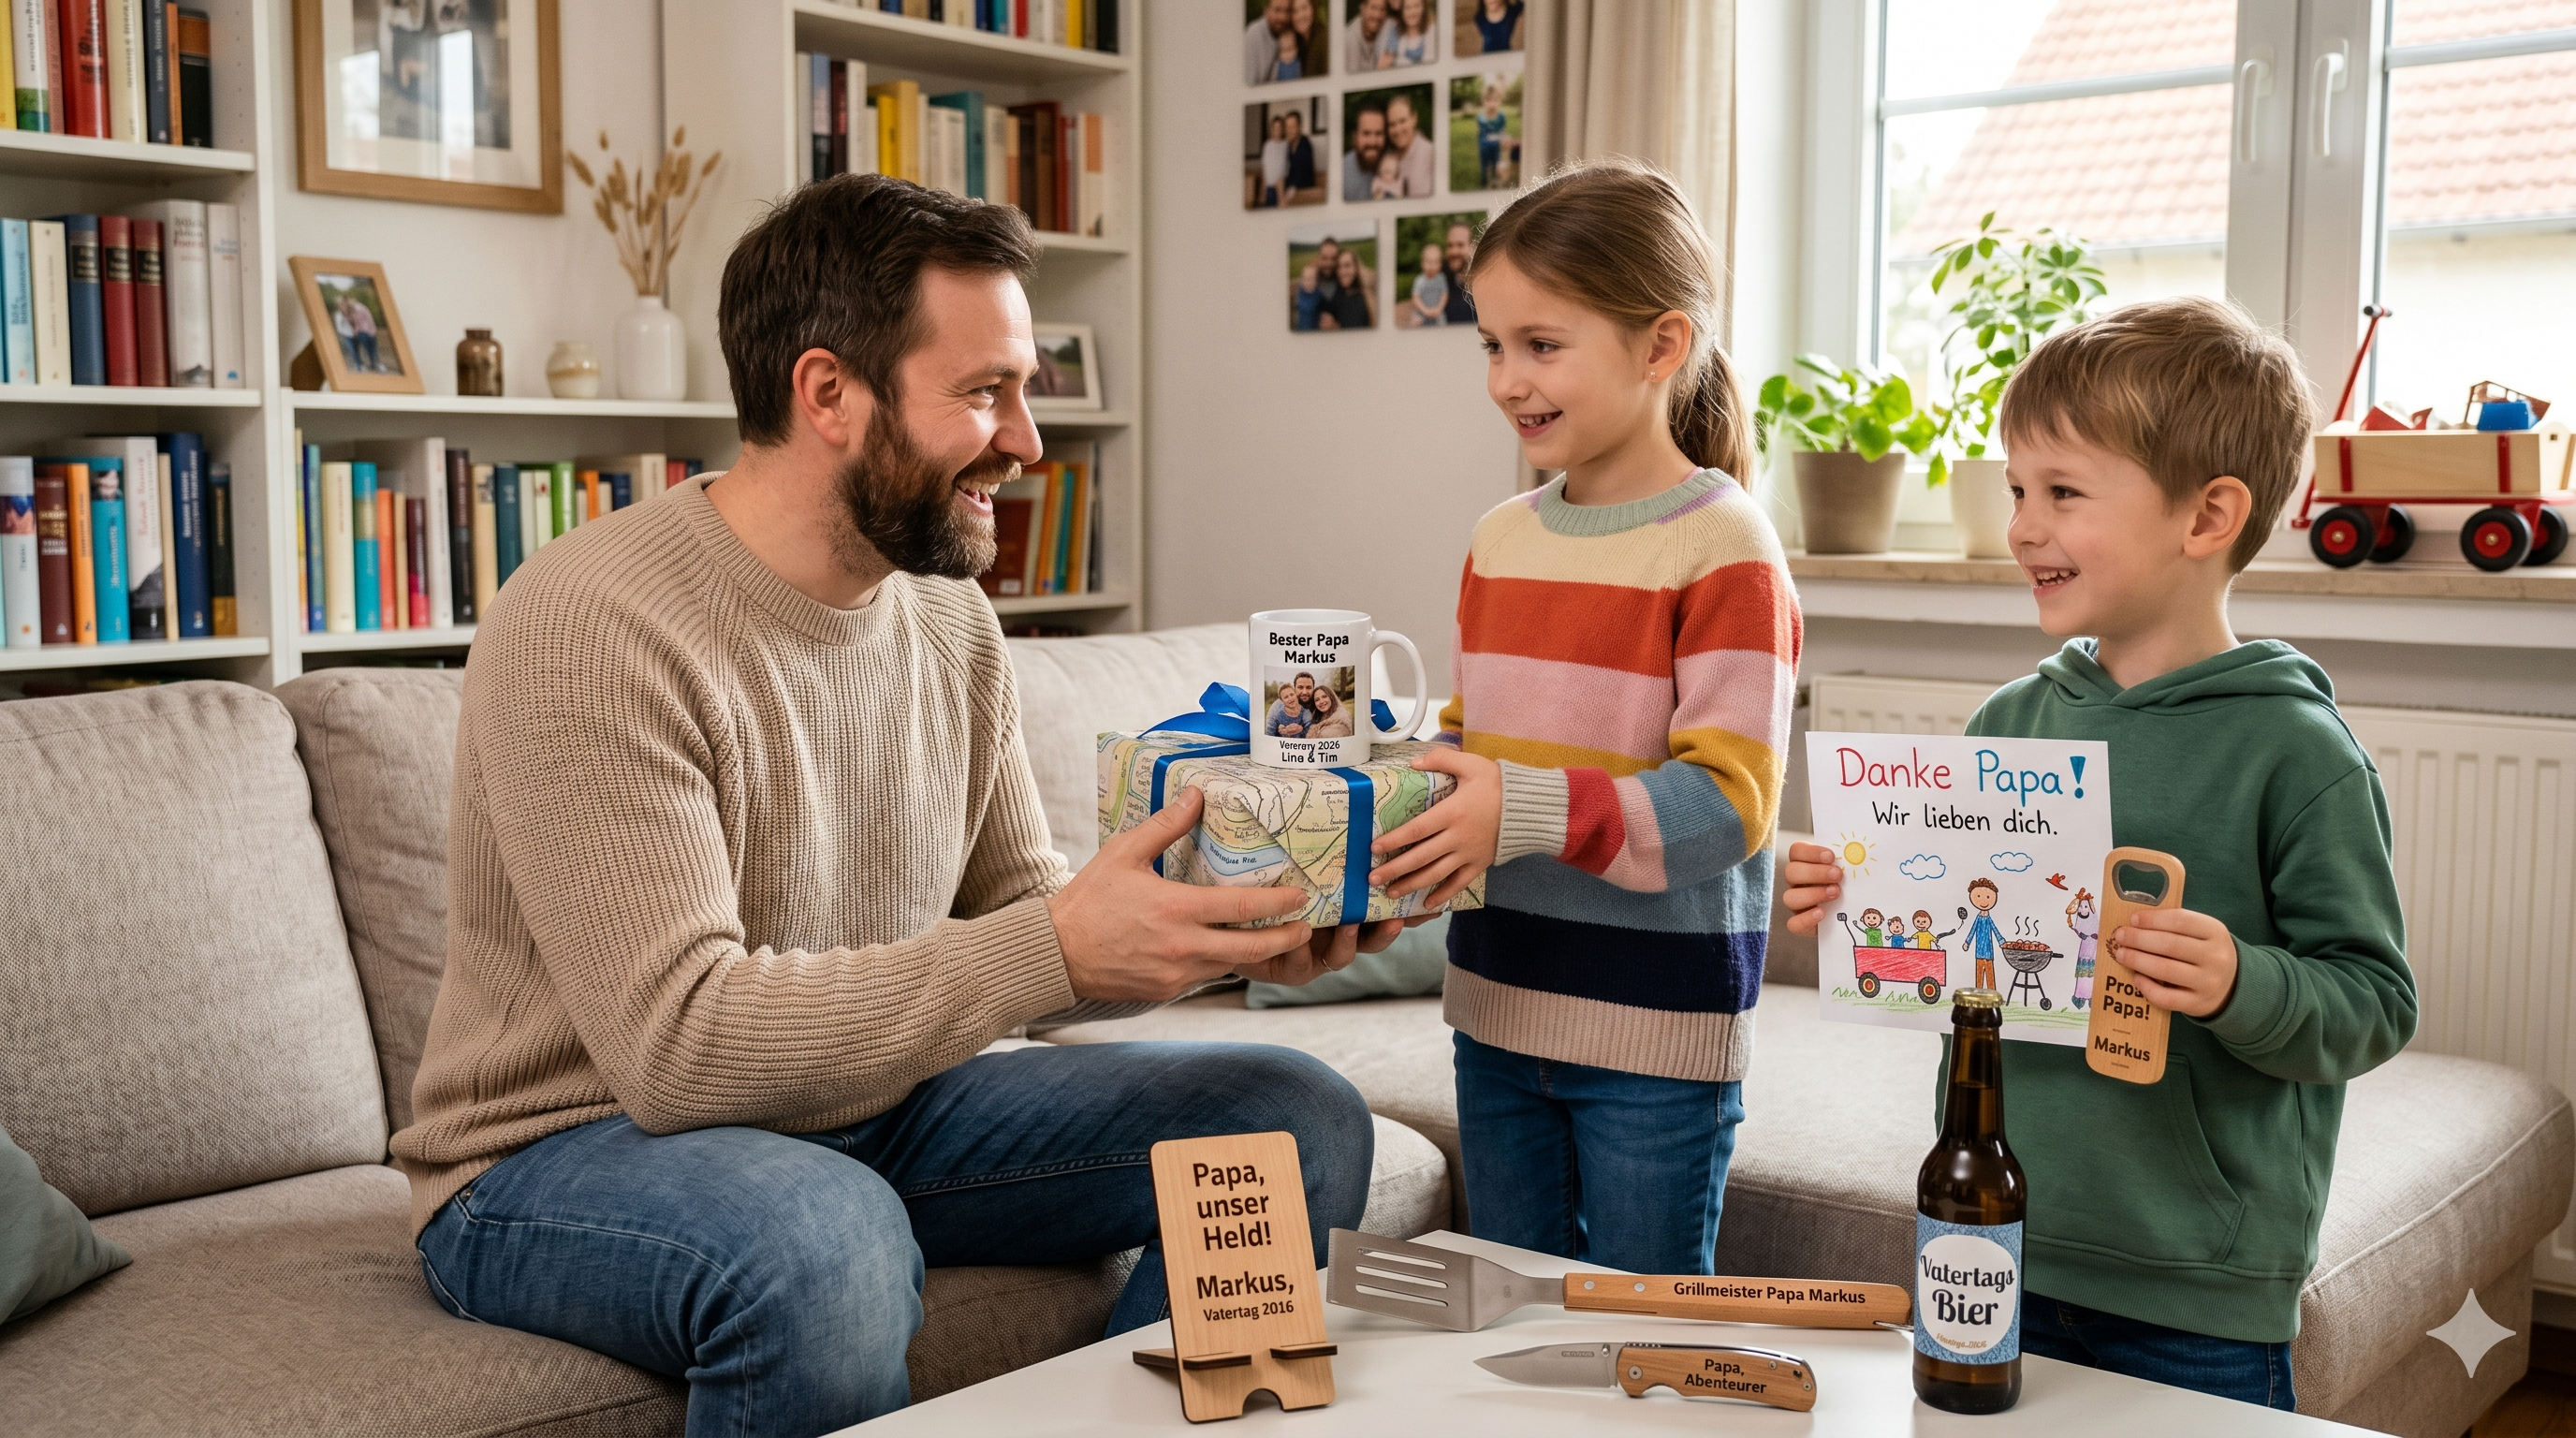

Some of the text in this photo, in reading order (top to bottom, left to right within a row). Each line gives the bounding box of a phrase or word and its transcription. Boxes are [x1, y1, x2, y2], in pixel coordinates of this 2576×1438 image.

[1269, 632, 1349, 649] Bester Papa
[1284, 650, 1337, 663] Markus
[1307, 751, 1315, 763] &
[1318, 753, 1338, 762] Tim
[1318, 741, 1340, 750] 2026
[1837, 747, 1952, 788] Danke
[1872, 801, 2058, 835] Wir lieben dich.
[2103, 995, 2150, 1020] Papa!
[2094, 1035, 2150, 1062] Markus
[1193, 1163, 1265, 1191] Papa,
[1197, 1196, 1269, 1219] unser
[1204, 1221, 1272, 1251] Held!
[1196, 1271, 1295, 1299] Markus,
[1920, 1255, 2014, 1293] Vatertags
[1674, 1282, 1866, 1303] Grillmeister Papa Markus
[1204, 1300, 1295, 1322] Vatertag 2016
[1932, 1289, 1998, 1326] Bier
[1705, 1359, 1745, 1376] Papa,
[1685, 1374, 1767, 1394] Abenteurer
